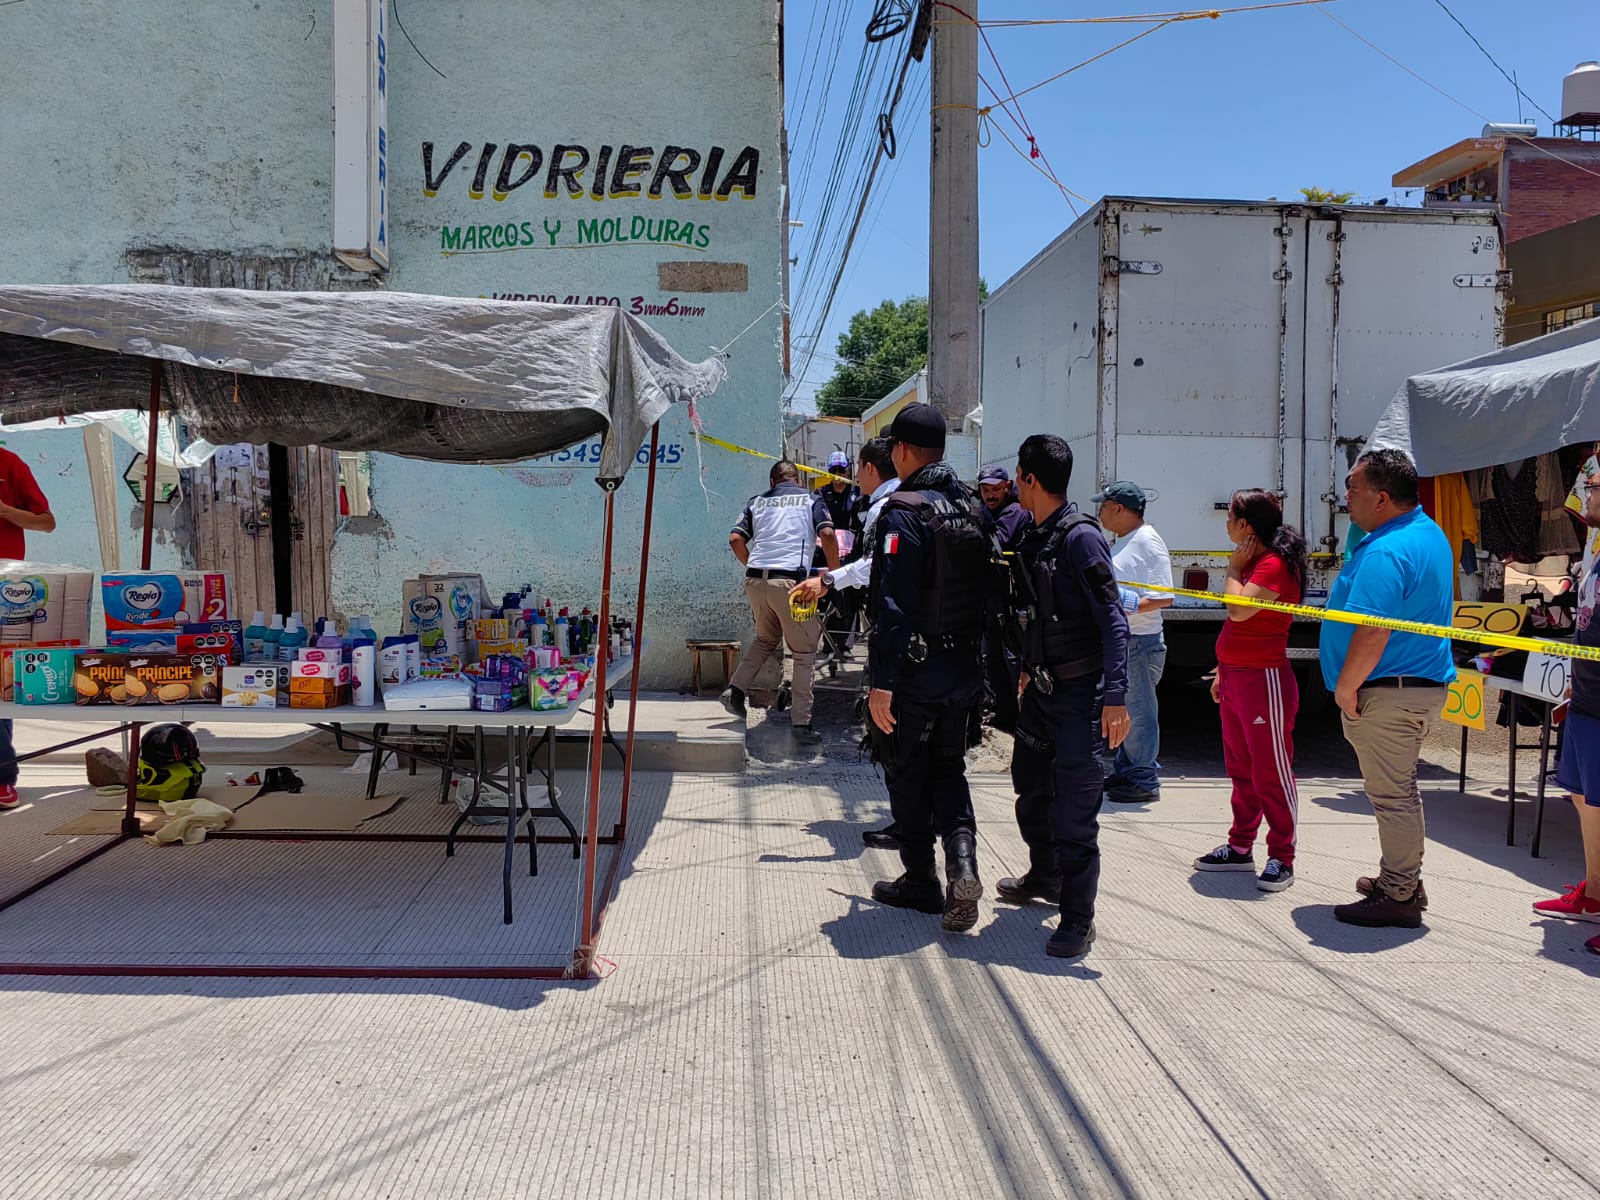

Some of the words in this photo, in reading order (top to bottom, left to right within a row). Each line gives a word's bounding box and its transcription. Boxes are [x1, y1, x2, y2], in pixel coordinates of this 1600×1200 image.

[420, 141, 760, 201] VIDRIERIA
[440, 222, 534, 250] MARCOS
[543, 216, 561, 246] Y
[577, 215, 711, 248] MOLDURAS
[757, 494, 809, 509] RESCATE
[4, 587, 31, 597] Regio
[128, 590, 157, 602] Regio
[414, 603, 437, 614] Regio
[125, 612, 150, 622] Rinde
[1454, 605, 1520, 633] 50
[1446, 679, 1482, 719] 50
